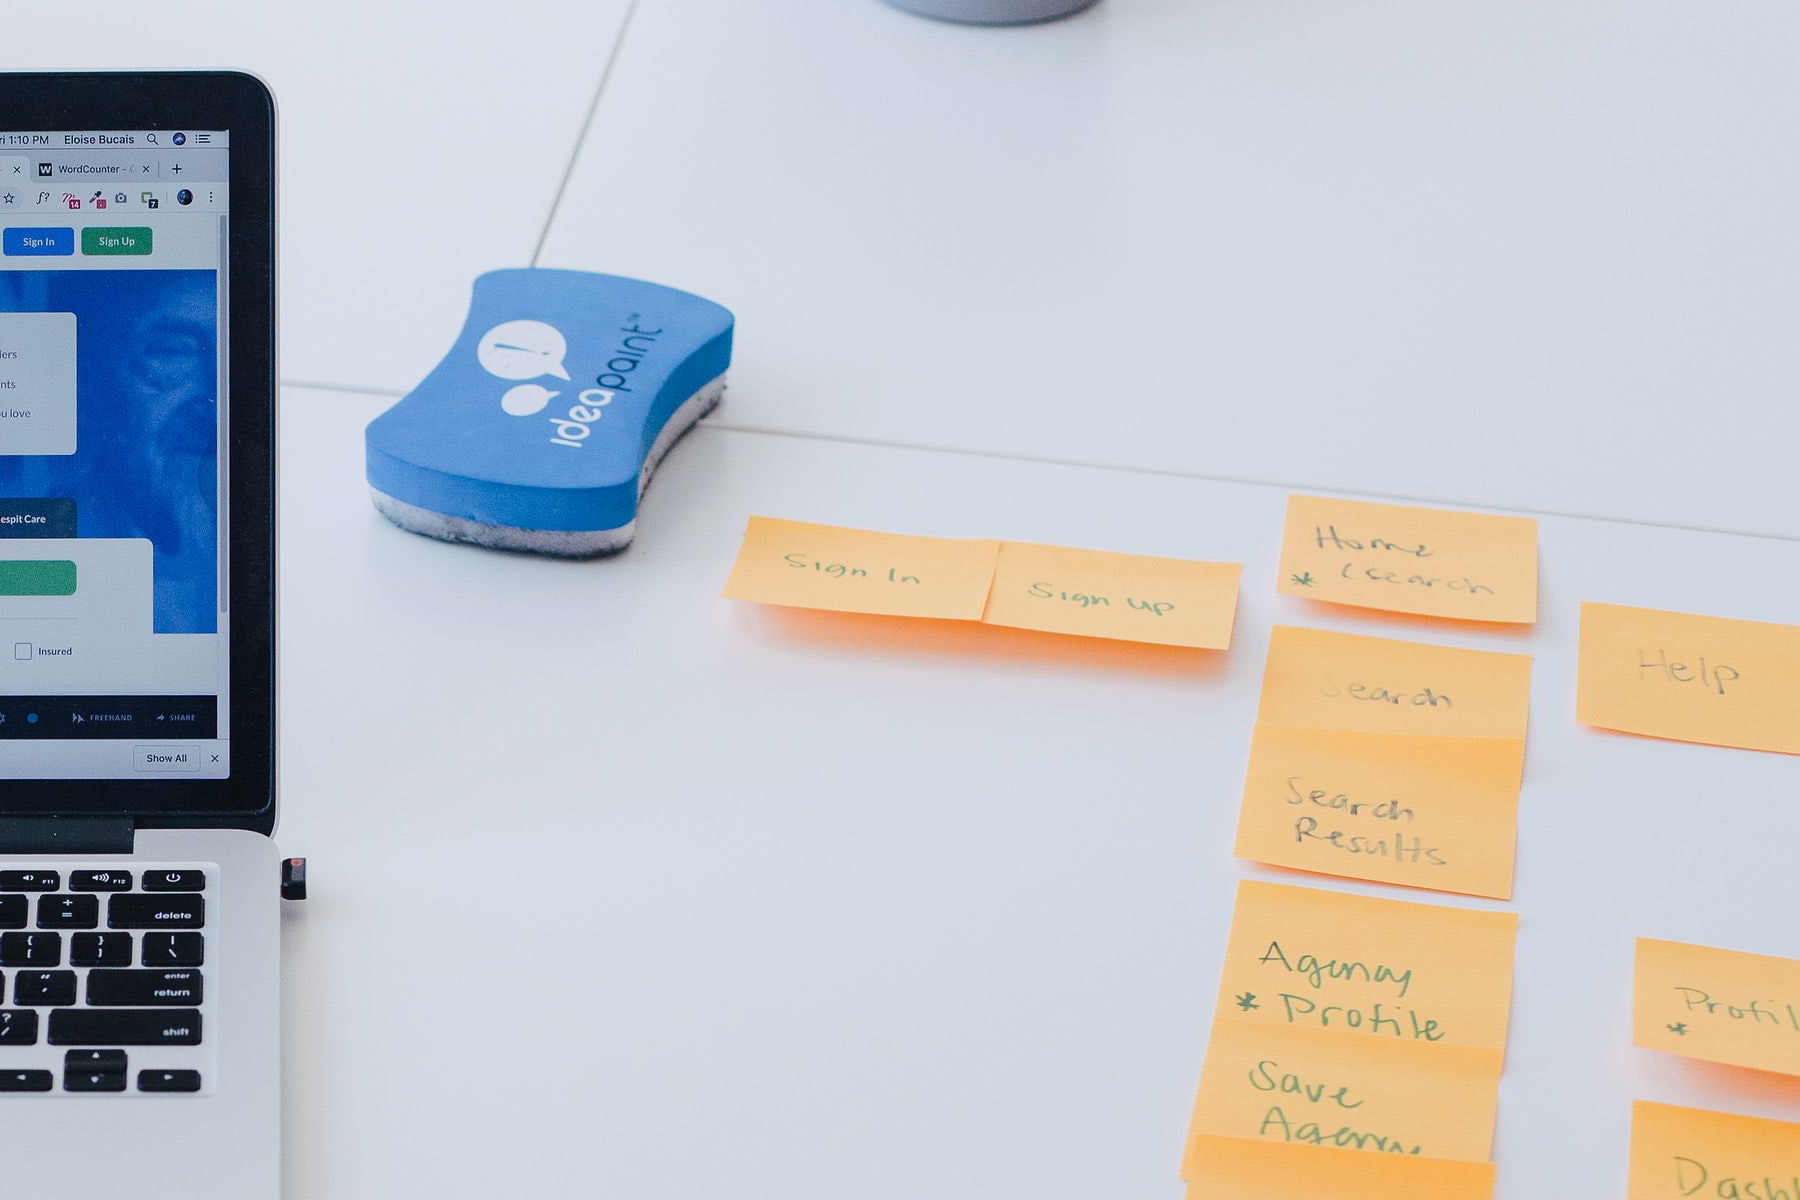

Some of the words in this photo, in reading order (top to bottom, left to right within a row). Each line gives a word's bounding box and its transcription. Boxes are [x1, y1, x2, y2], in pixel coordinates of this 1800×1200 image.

[9, 135, 29, 145] 1:10
[32, 135, 49, 144] PM
[64, 134, 96, 144] Eloise
[99, 134, 134, 144] Bucais
[58, 165, 120, 173] WordCounter
[23, 237, 43, 248] Sign
[45, 237, 55, 246] In
[99, 237, 119, 247] Sign
[121, 237, 135, 247] Up
[10, 409, 31, 418] love
[24, 514, 46, 523] Care
[1315, 524, 1436, 558] Home
[783, 553, 868, 578] Sign
[888, 568, 921, 585] In
[1027, 582, 1110, 609] Sign
[38, 647, 72, 655] Insured
[1639, 649, 1740, 695] Help
[147, 754, 172, 763] Show
[175, 754, 187, 762] All
[1285, 775, 1414, 822] Search
[1295, 816, 1447, 866] Results
[153, 988, 190, 997] return
[1278, 992, 1446, 1042] Profile
[163, 1028, 189, 1036] shift
[1249, 1060, 1365, 1109] Save
